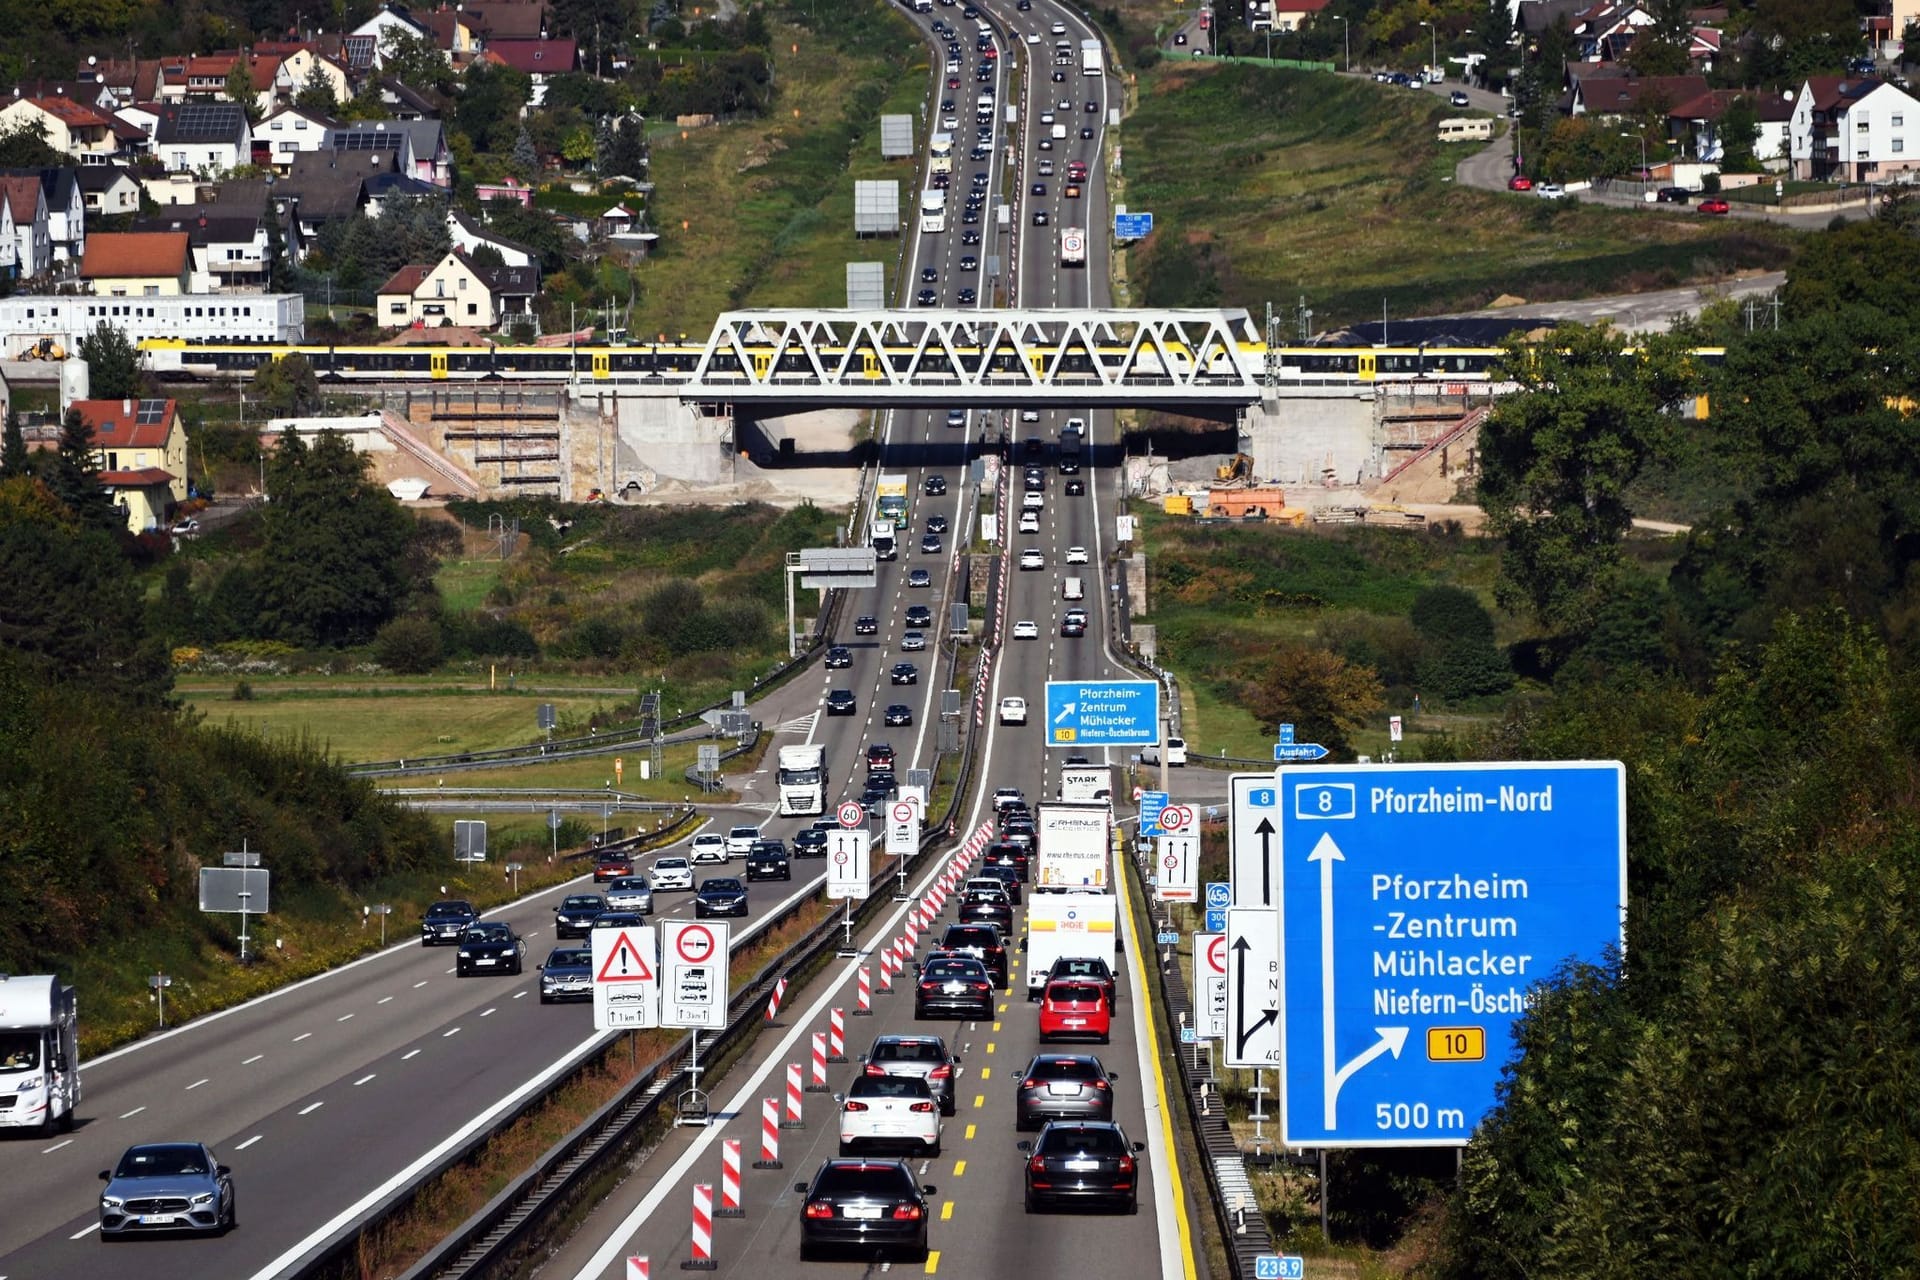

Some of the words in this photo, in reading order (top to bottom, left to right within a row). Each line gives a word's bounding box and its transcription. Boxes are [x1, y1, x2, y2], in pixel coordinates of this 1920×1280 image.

[1080, 688, 1141, 699] Pforzheim-
[1080, 702, 1126, 712] Zentrum
[1080, 715, 1136, 726] Mühlacker
[1061, 731, 1070, 739] 10
[1280, 747, 1316, 756] Ausfahrt
[1067, 776, 1097, 784] STARK
[1261, 792, 1269, 804] 8
[1318, 791, 1332, 811] 8
[1370, 786, 1552, 814] Pforzheim-Nord
[843, 810, 857, 820] 60
[1164, 813, 1178, 824] 60
[1372, 873, 1529, 901] Pforzheim
[1211, 890, 1228, 902] 45a
[1373, 911, 1517, 938] -Zentrum
[1373, 949, 1532, 977] Mühlacker
[1445, 1034, 1468, 1054] 10
[1375, 1103, 1432, 1129] 500
[1438, 1110, 1464, 1128] m
